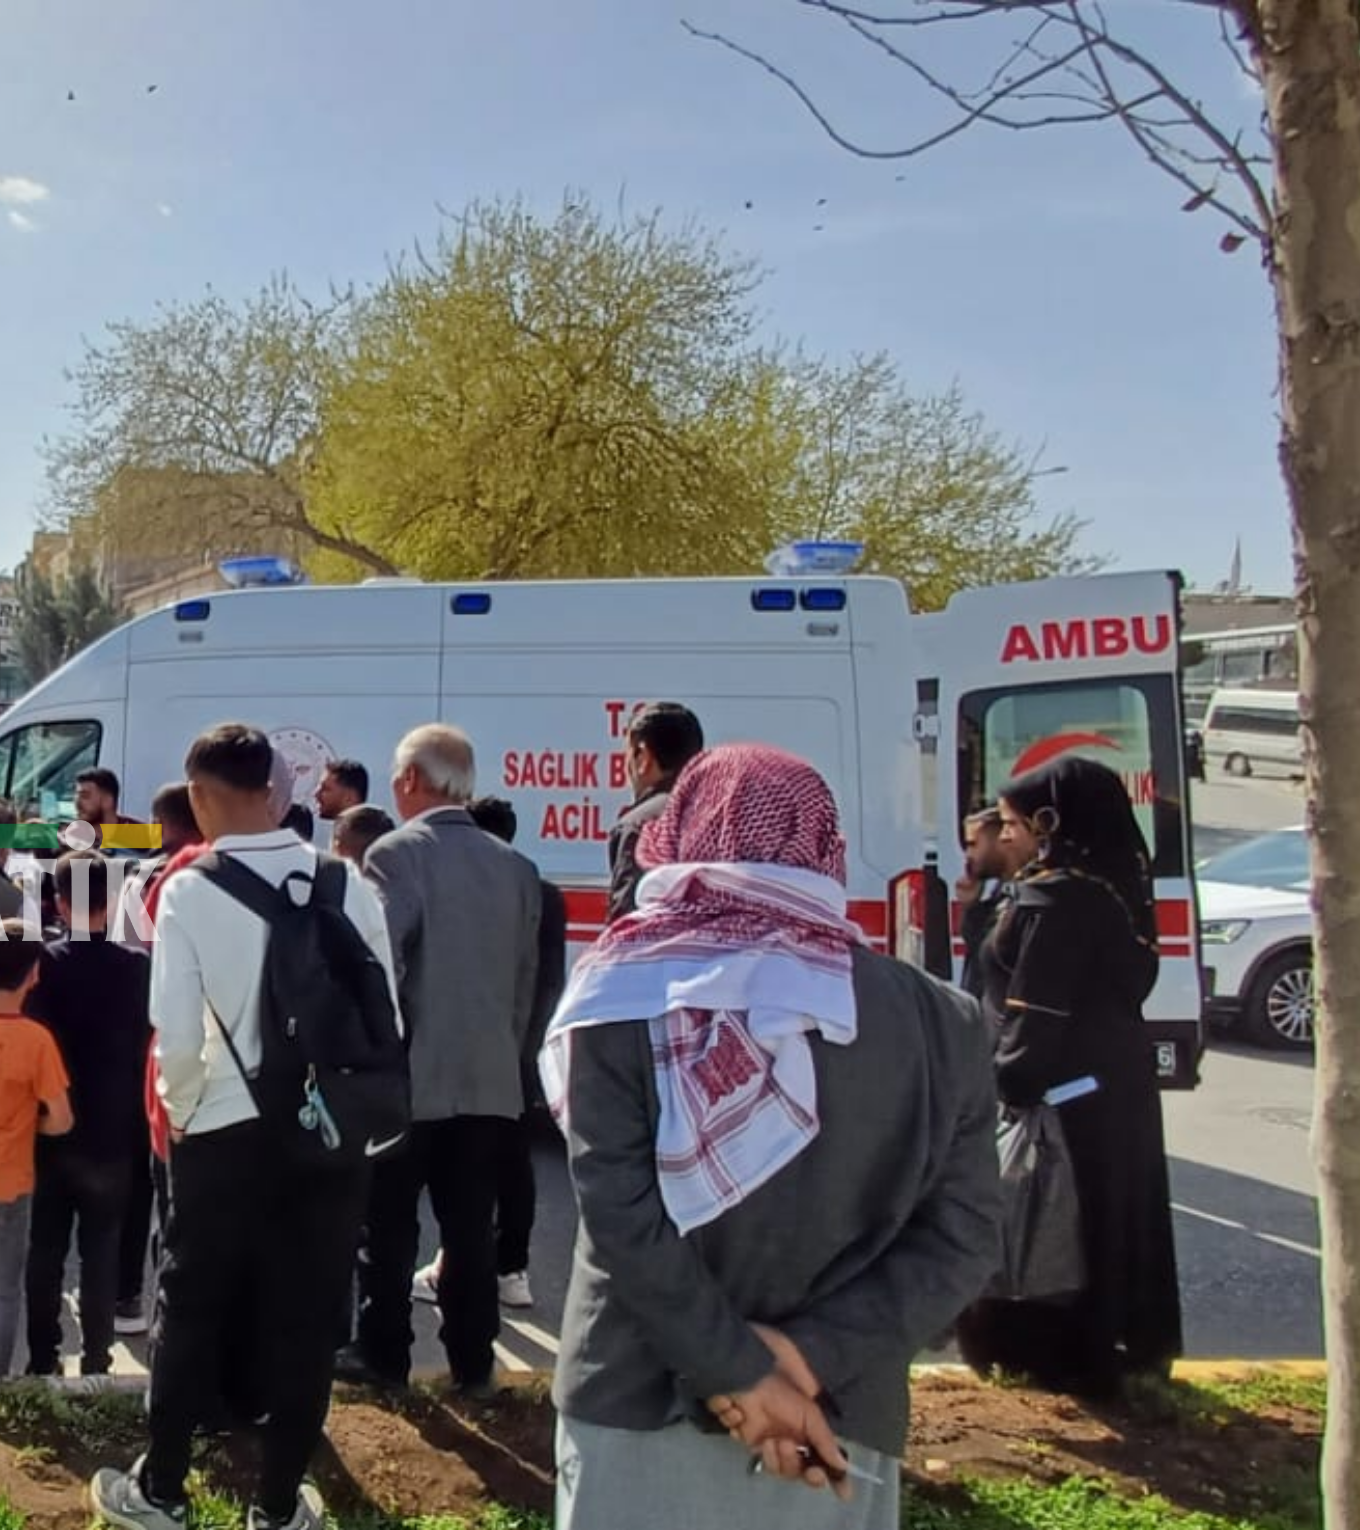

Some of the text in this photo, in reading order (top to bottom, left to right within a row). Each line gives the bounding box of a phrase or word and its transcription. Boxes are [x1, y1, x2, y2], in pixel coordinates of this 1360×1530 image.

[1000, 614, 1171, 664] AMBU
[503, 748, 599, 789] SAĞLIK
[540, 797, 608, 841] ACİL
